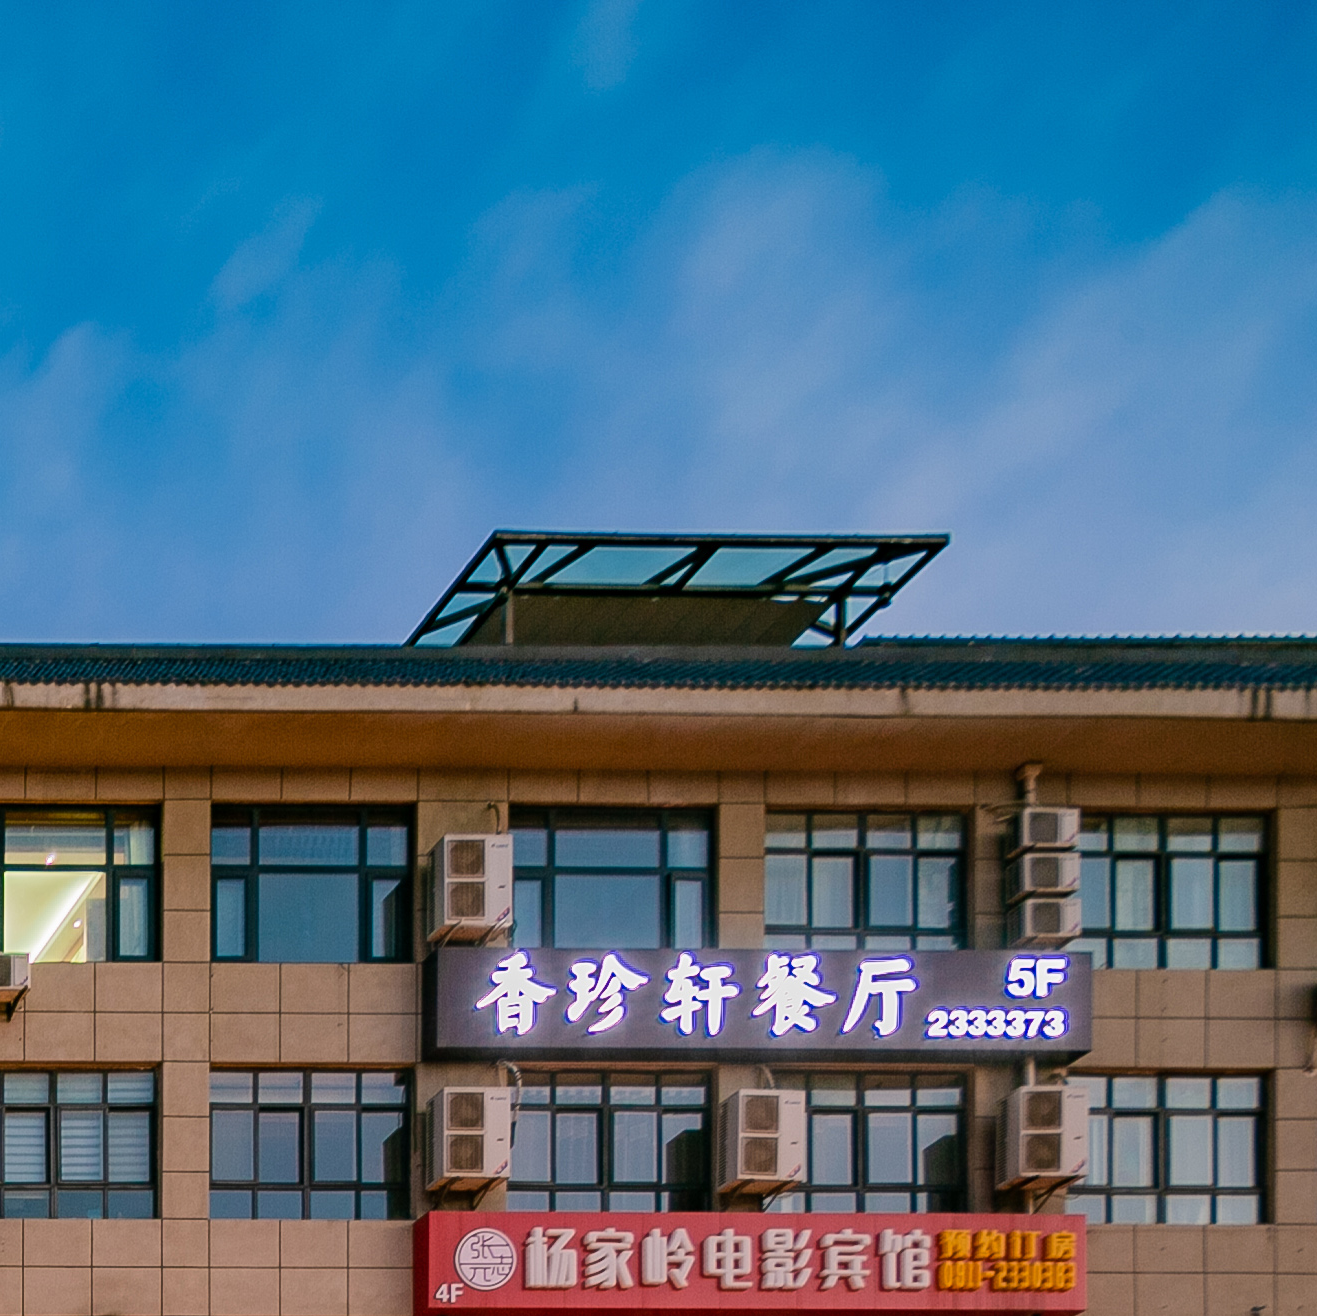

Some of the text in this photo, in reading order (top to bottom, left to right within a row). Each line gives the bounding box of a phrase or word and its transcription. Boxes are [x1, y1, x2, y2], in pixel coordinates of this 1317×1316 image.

[474, 948, 921, 1040] 香珍轩餐厅
[1004, 955, 1069, 999] 5F
[925, 1006, 1068, 1040] 2333373
[524, 1226, 932, 1291] 杨家岭电影宾馆
[435, 1283, 465, 1303] 4F
